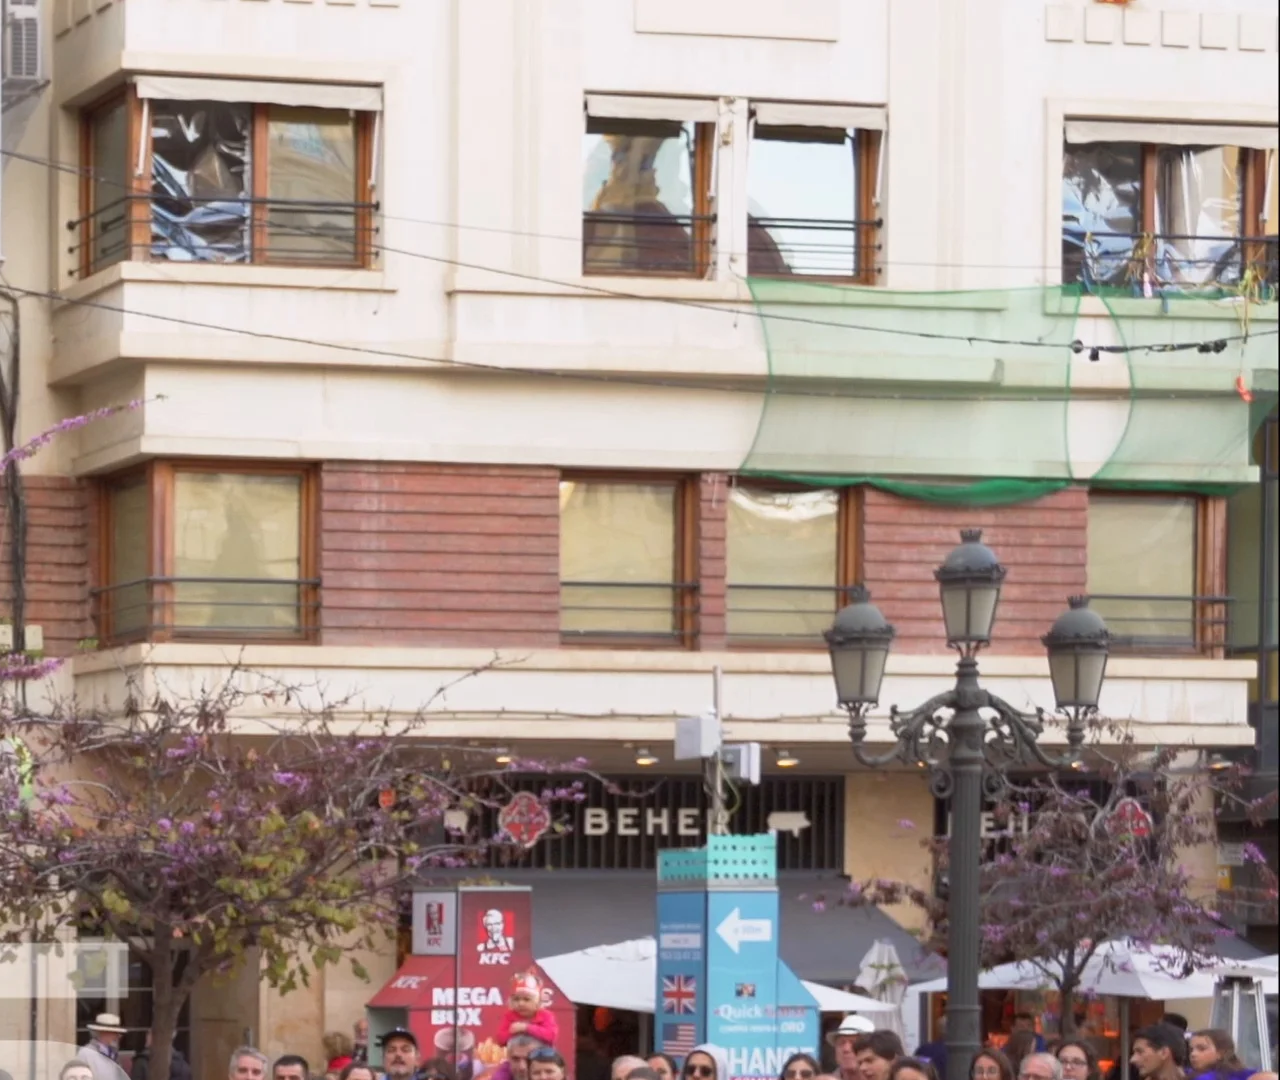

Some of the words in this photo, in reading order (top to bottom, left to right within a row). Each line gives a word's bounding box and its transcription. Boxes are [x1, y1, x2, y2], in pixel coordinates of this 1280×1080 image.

[478, 952, 511, 965] KFC
[391, 975, 428, 989] KFC
[431, 986, 504, 1006] MEGA
[430, 1007, 483, 1027] BOX
[719, 1003, 763, 1024] Quick
